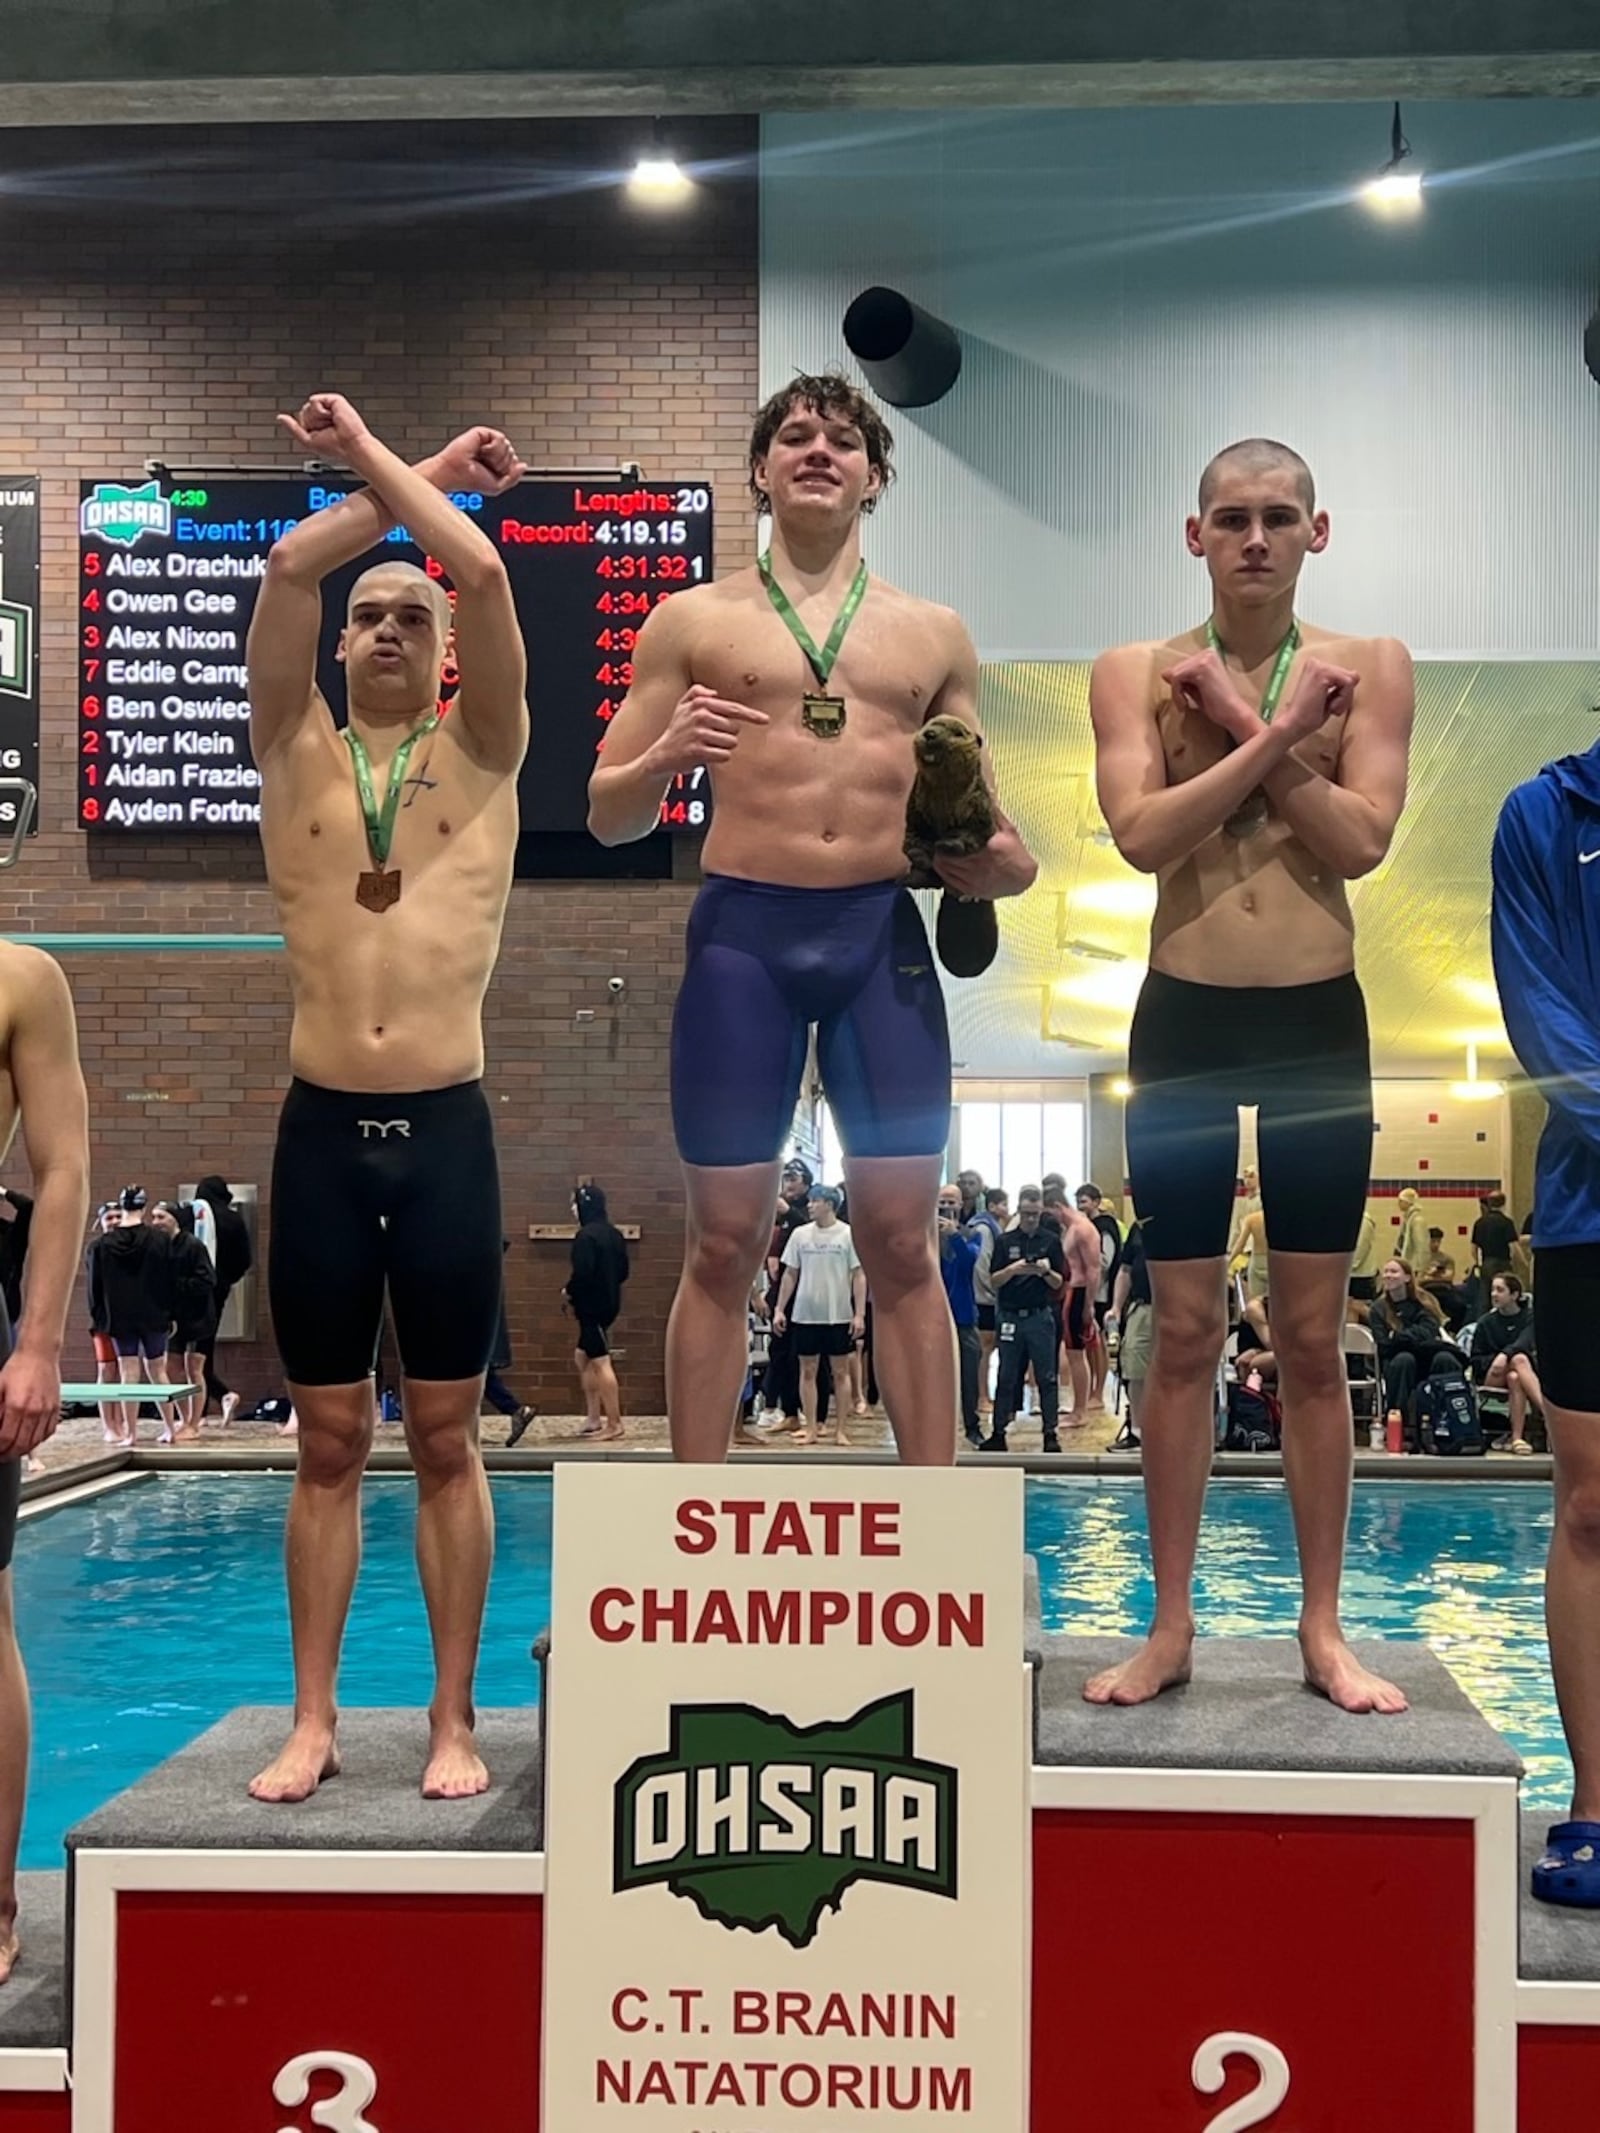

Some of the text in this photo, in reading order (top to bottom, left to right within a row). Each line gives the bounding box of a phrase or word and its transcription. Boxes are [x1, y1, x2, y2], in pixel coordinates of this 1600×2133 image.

[171, 489, 207, 506] 4:30
[86, 500, 165, 528] OHSAA
[85, 553, 100, 577] 5
[106, 552, 161, 577] Alex
[596, 555, 704, 579] 4:31.32 1
[83, 590, 237, 614] 4 Owen Gee
[84, 625, 237, 650] 3 Alex Nixon
[84, 660, 99, 681] 7
[107, 660, 177, 684] Eddie
[83, 696, 100, 720] 6
[107, 696, 156, 720] Ben
[83, 731, 235, 758] 2 Tyler Klein
[85, 765, 98, 786] 1
[106, 763, 176, 787] Aidan
[83, 798, 99, 821] 8
[105, 798, 183, 826] Ayden
[688, 801, 705, 825] 8
[357, 1120, 411, 1138] TYR
[675, 1499, 901, 1556] STATE
[589, 1588, 985, 1647] CHAMPION
[633, 1764, 938, 1872] OHSAA
[611, 1988, 956, 2038] C.T. BRANIN
[595, 2061, 972, 2111] NATATORIUM
